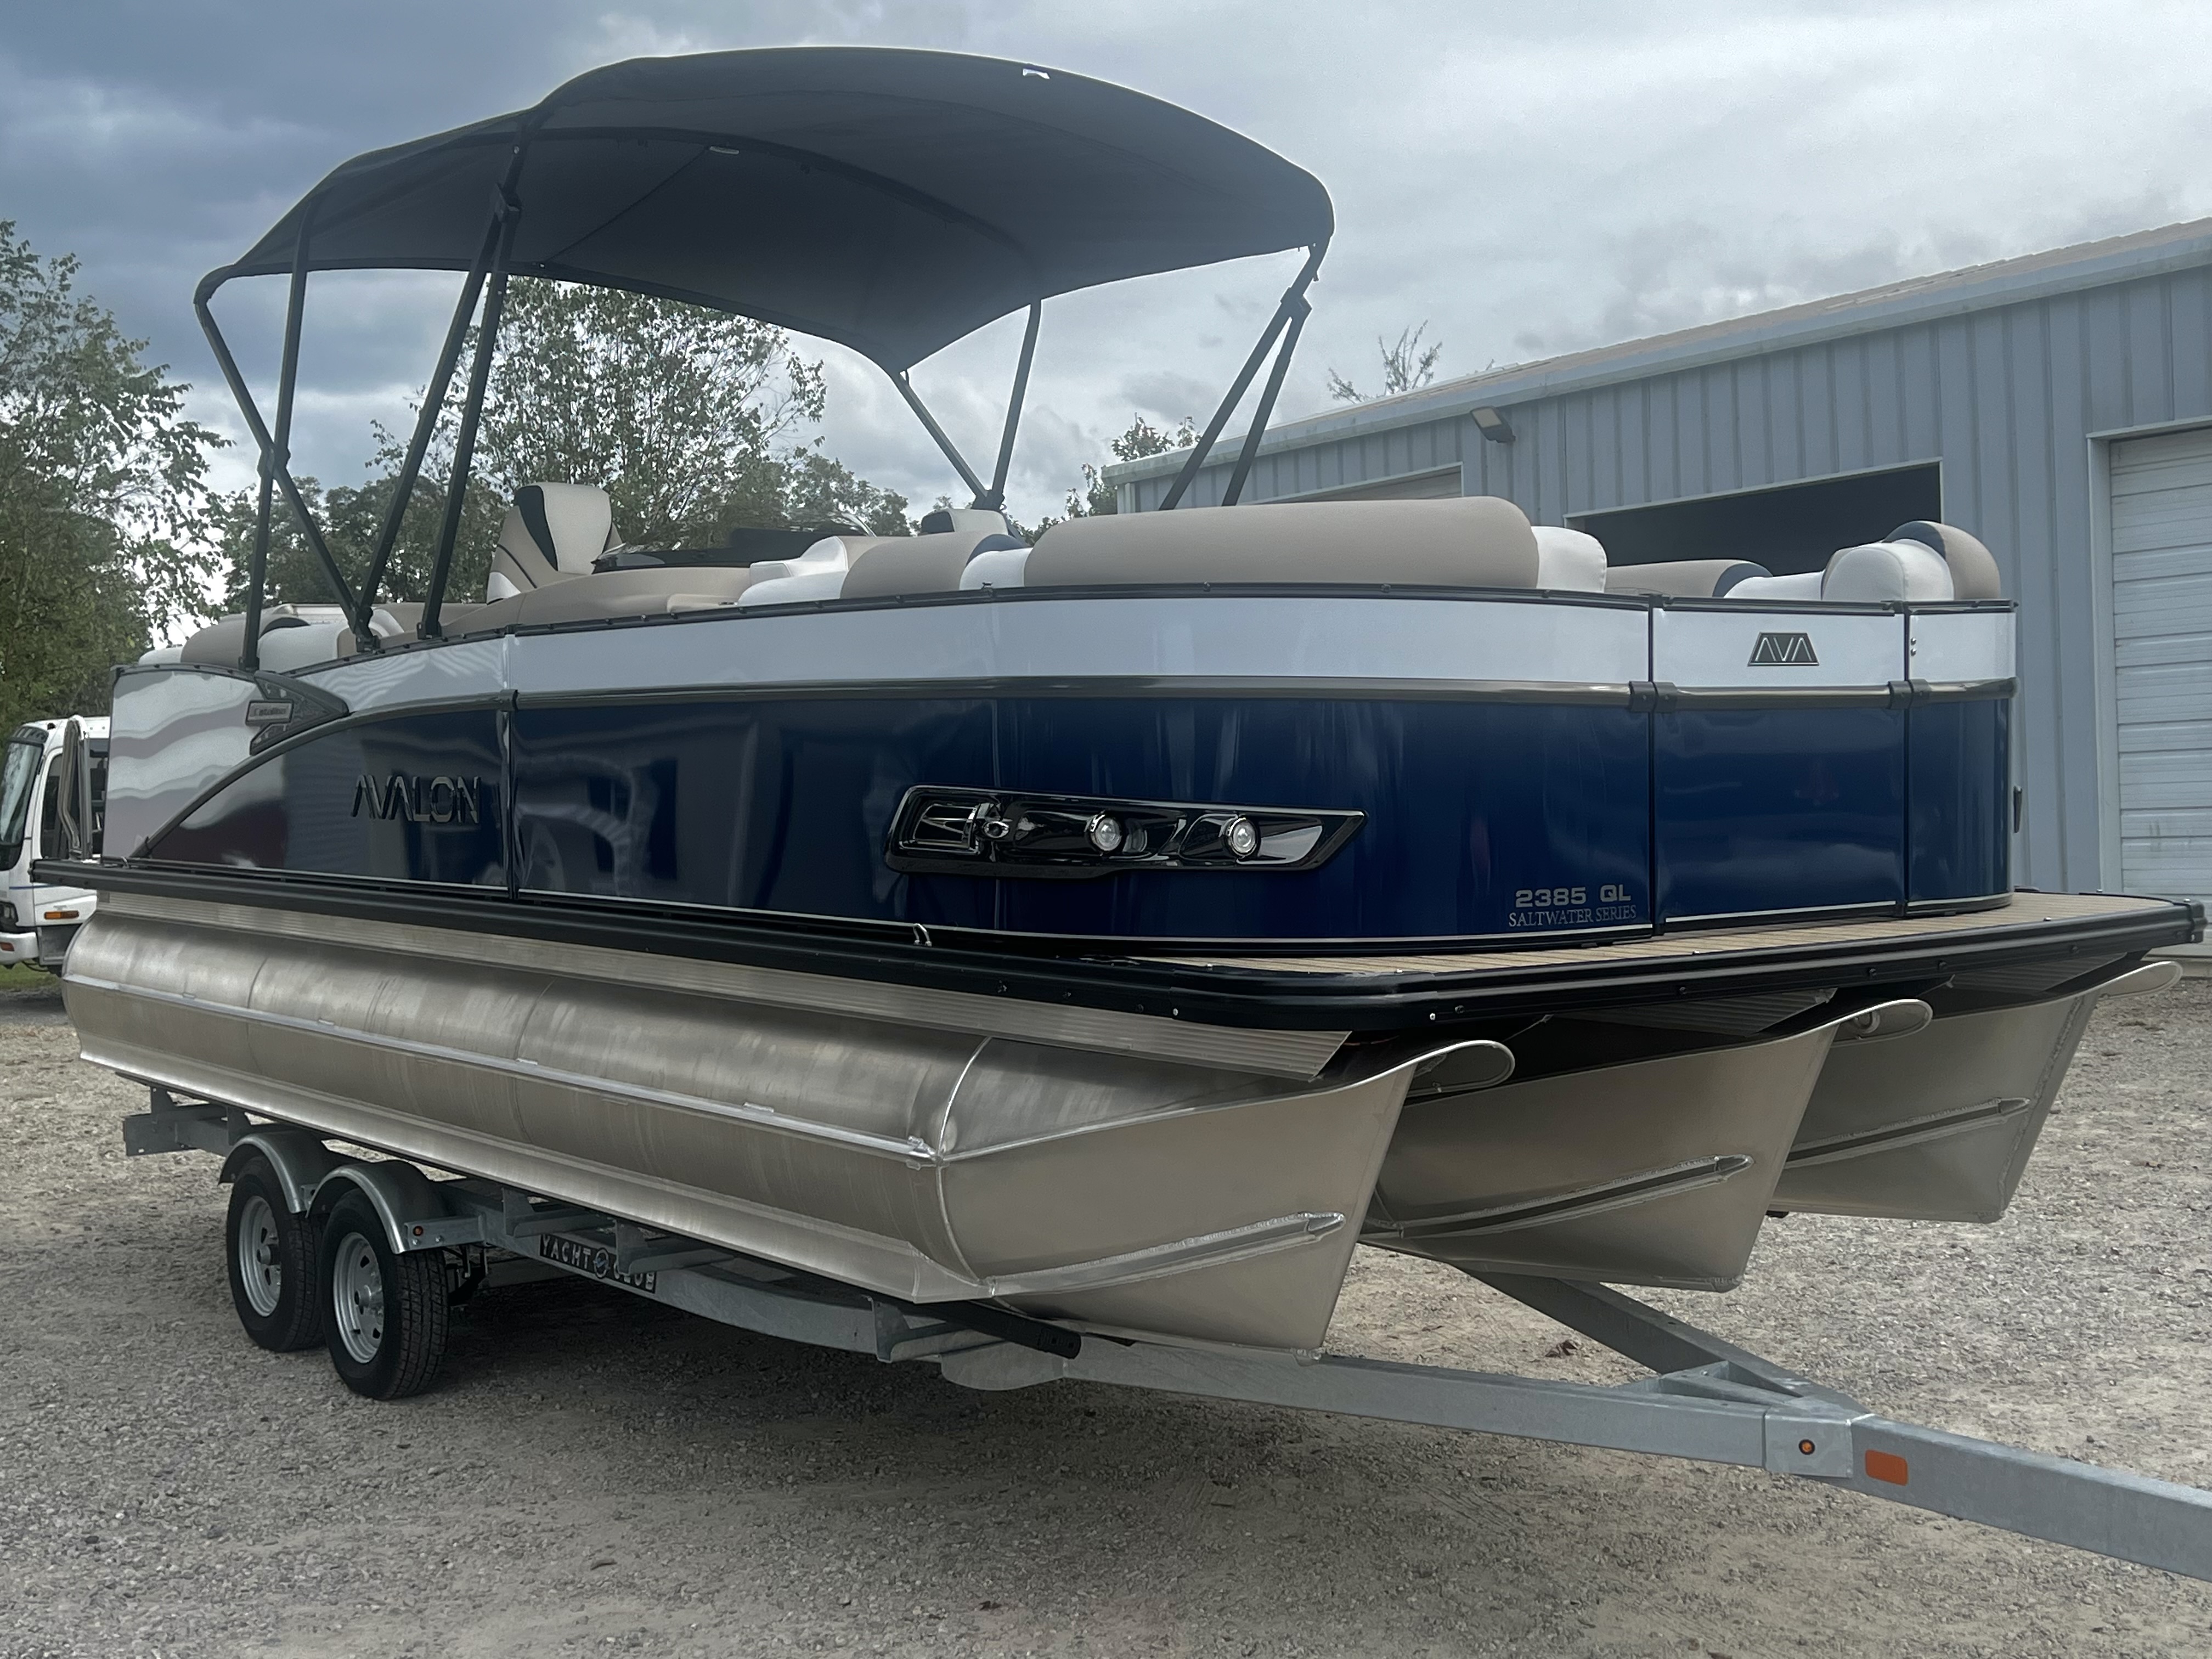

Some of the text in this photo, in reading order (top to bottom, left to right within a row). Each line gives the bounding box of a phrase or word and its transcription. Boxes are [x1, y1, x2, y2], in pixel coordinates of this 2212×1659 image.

[352, 774, 481, 823] AVALON
[1515, 884, 1632, 908] 2385 QL
[1509, 905, 1637, 927] SALTWATER SERIES
[541, 1235, 592, 1269] YACHT
